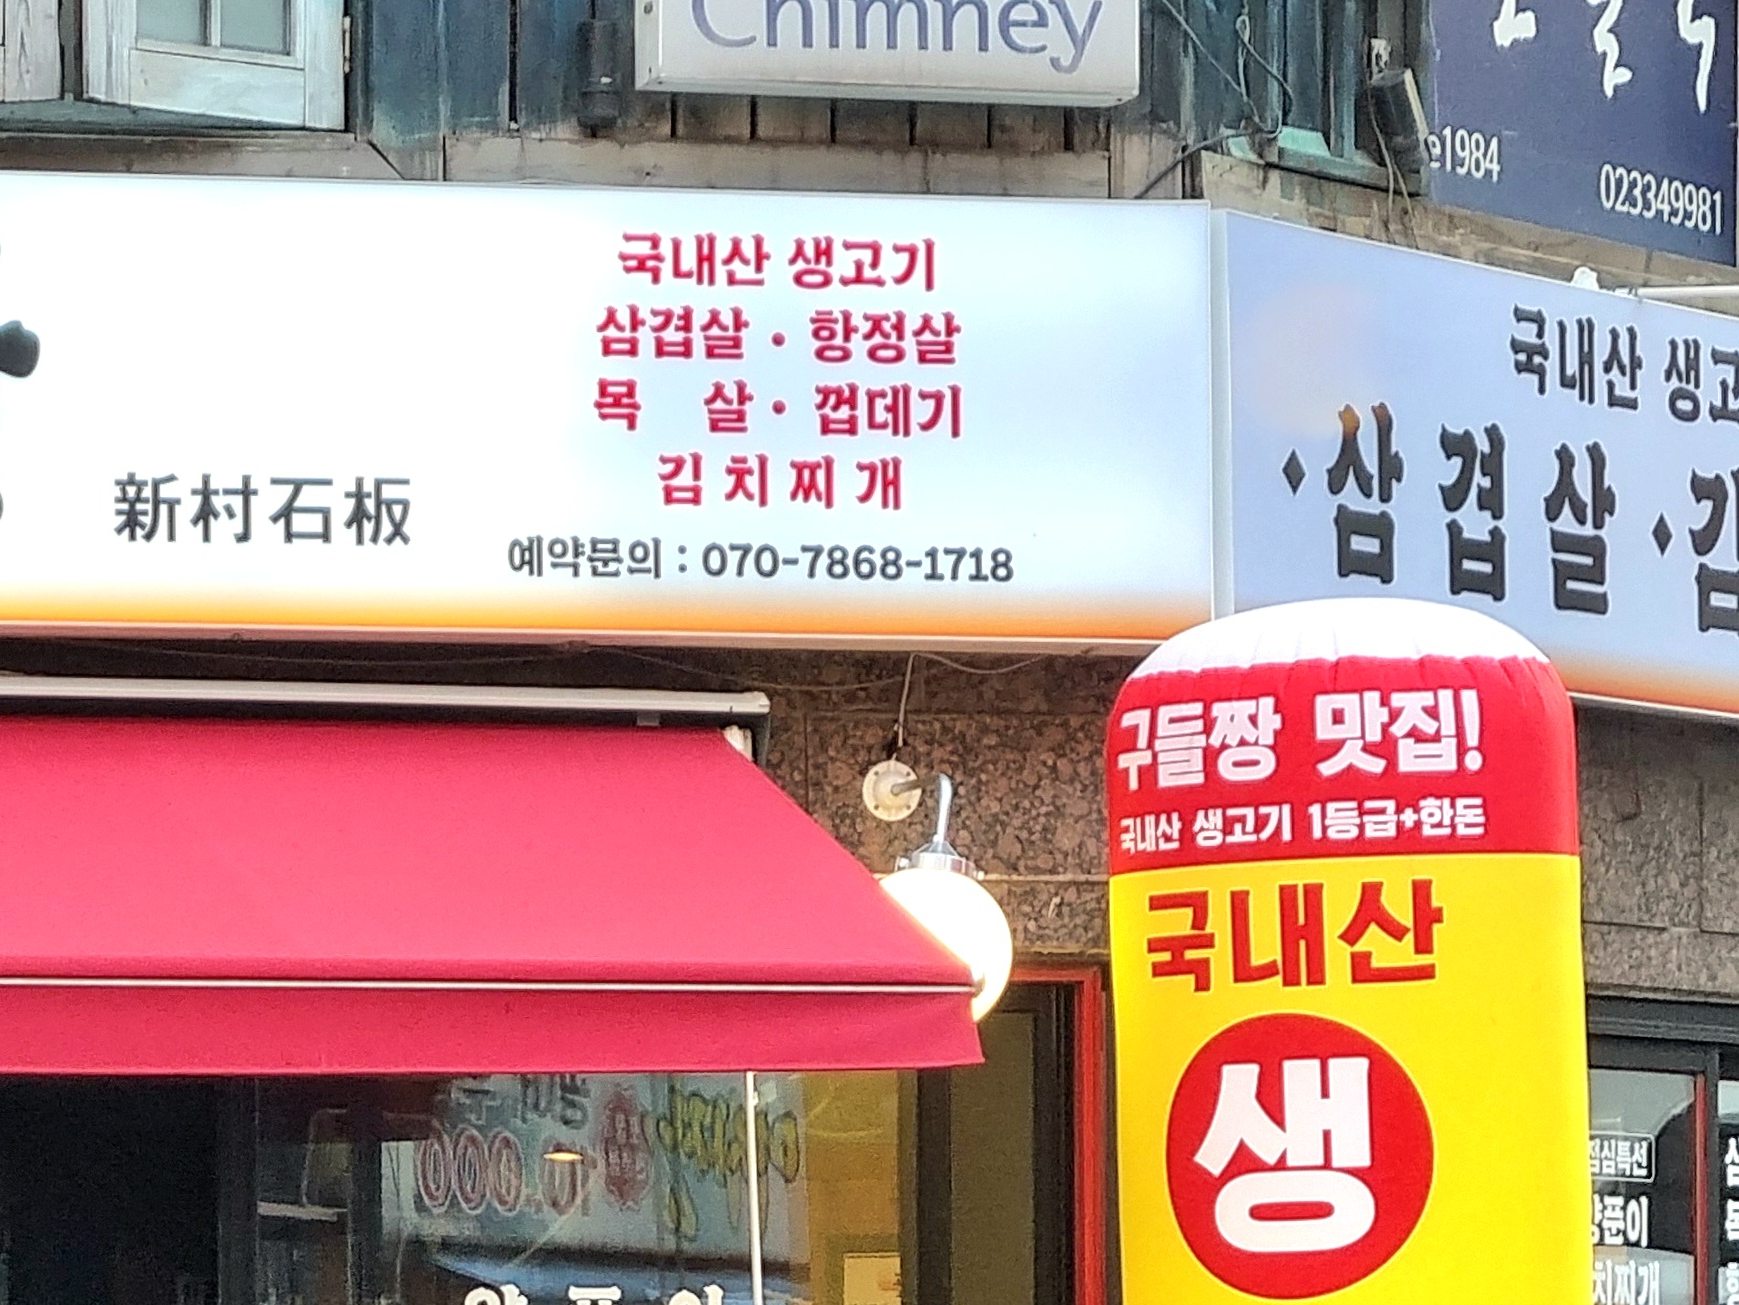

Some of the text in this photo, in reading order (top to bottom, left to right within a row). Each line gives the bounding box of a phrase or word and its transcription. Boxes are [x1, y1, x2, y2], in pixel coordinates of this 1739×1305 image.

[692, 0, 1103, 75] Chimney
[1599, 164, 1723, 236] 023349981
[617, 232, 936, 292] 국내산 생고기
[596, 304, 962, 366] 삼겹살 항정살
[1510, 303, 1643, 412] 국내산
[814, 382, 962, 439] 껍데기
[113, 471, 411, 547] 新村石板
[658, 452, 903, 511] 김치찌개
[1325, 401, 1618, 616] 삼겹살
[701, 541, 1015, 583] 070-7868-1718
[1117, 688, 1483, 791] 구들짱 맛집!
[1120, 797, 1486, 855] 국내산 생고기 1등급+한돈
[1146, 878, 1444, 993] 국내산
[1193, 1056, 1376, 1253] 생
